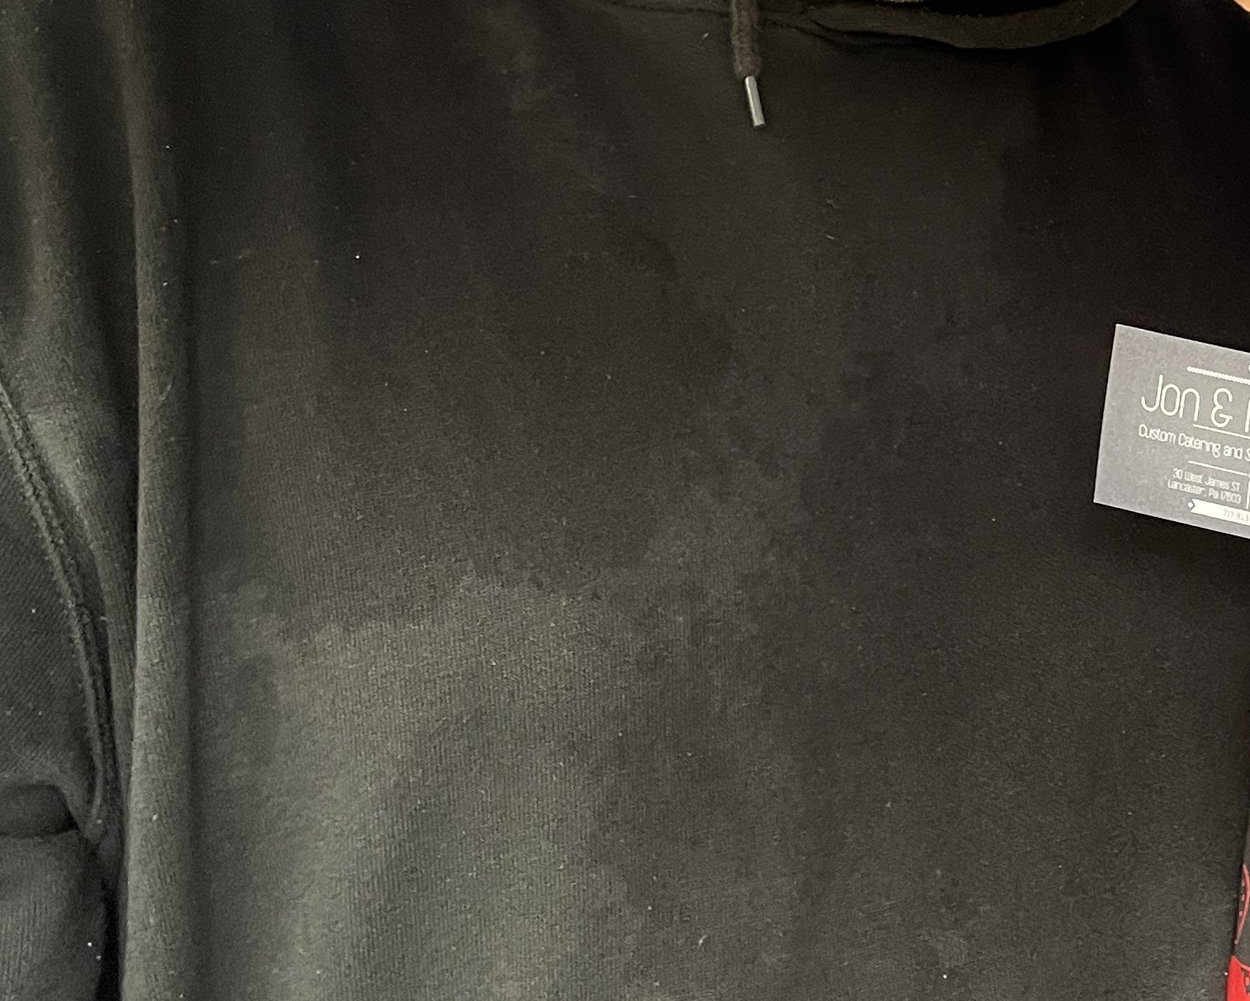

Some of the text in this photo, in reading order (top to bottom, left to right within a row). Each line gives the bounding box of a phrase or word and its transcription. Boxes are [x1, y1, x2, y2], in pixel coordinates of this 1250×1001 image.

[1140, 374, 1200, 421] Jon
[1210, 387, 1233, 427] &
[1138, 424, 1175, 443] Custom
[1177, 433, 1220, 457] Catering
[1223, 445, 1243, 459] and
[1172, 468, 1183, 479] 30
[1184, 471, 1202, 483] West
[1204, 476, 1228, 489] James
